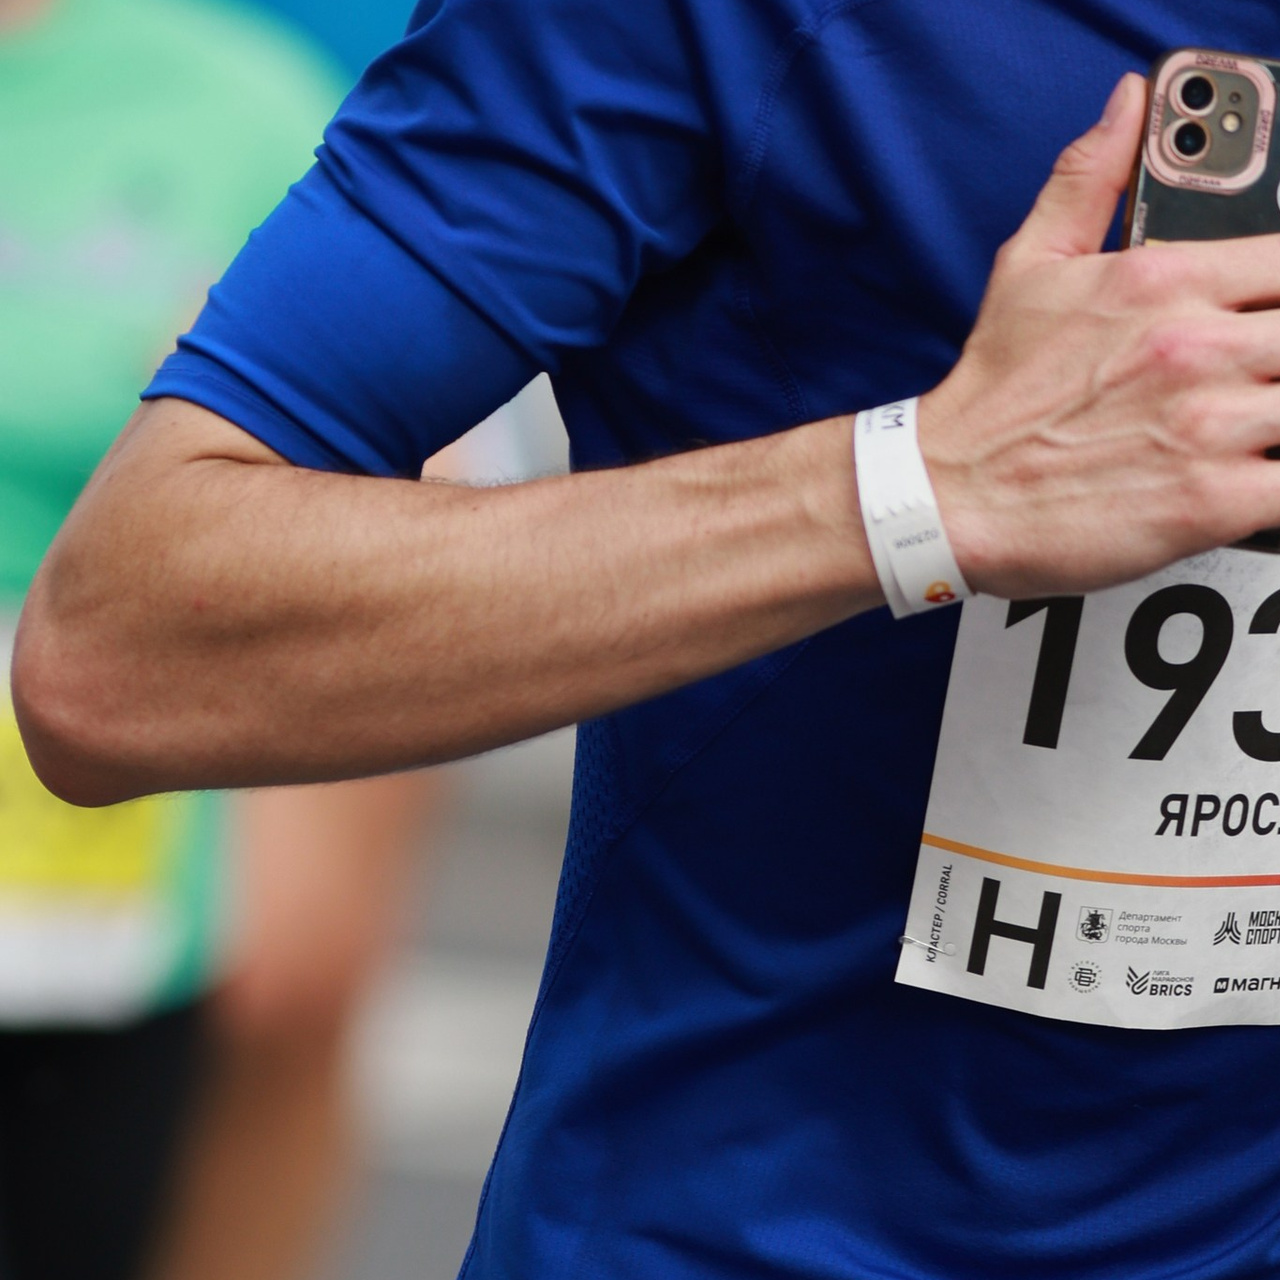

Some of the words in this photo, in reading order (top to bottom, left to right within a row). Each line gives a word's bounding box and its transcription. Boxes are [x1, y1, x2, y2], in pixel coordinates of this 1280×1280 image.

[926, 913, 944, 963] КЛАСТЕР
[936, 864, 953, 906] CORRAL
[1118, 911, 1183, 923] Департамент
[1117, 924, 1151, 934] спорта
[1115, 935, 1149, 945] города
[1151, 936, 1188, 946] Москвы
[1150, 984, 1193, 997] BRICS
